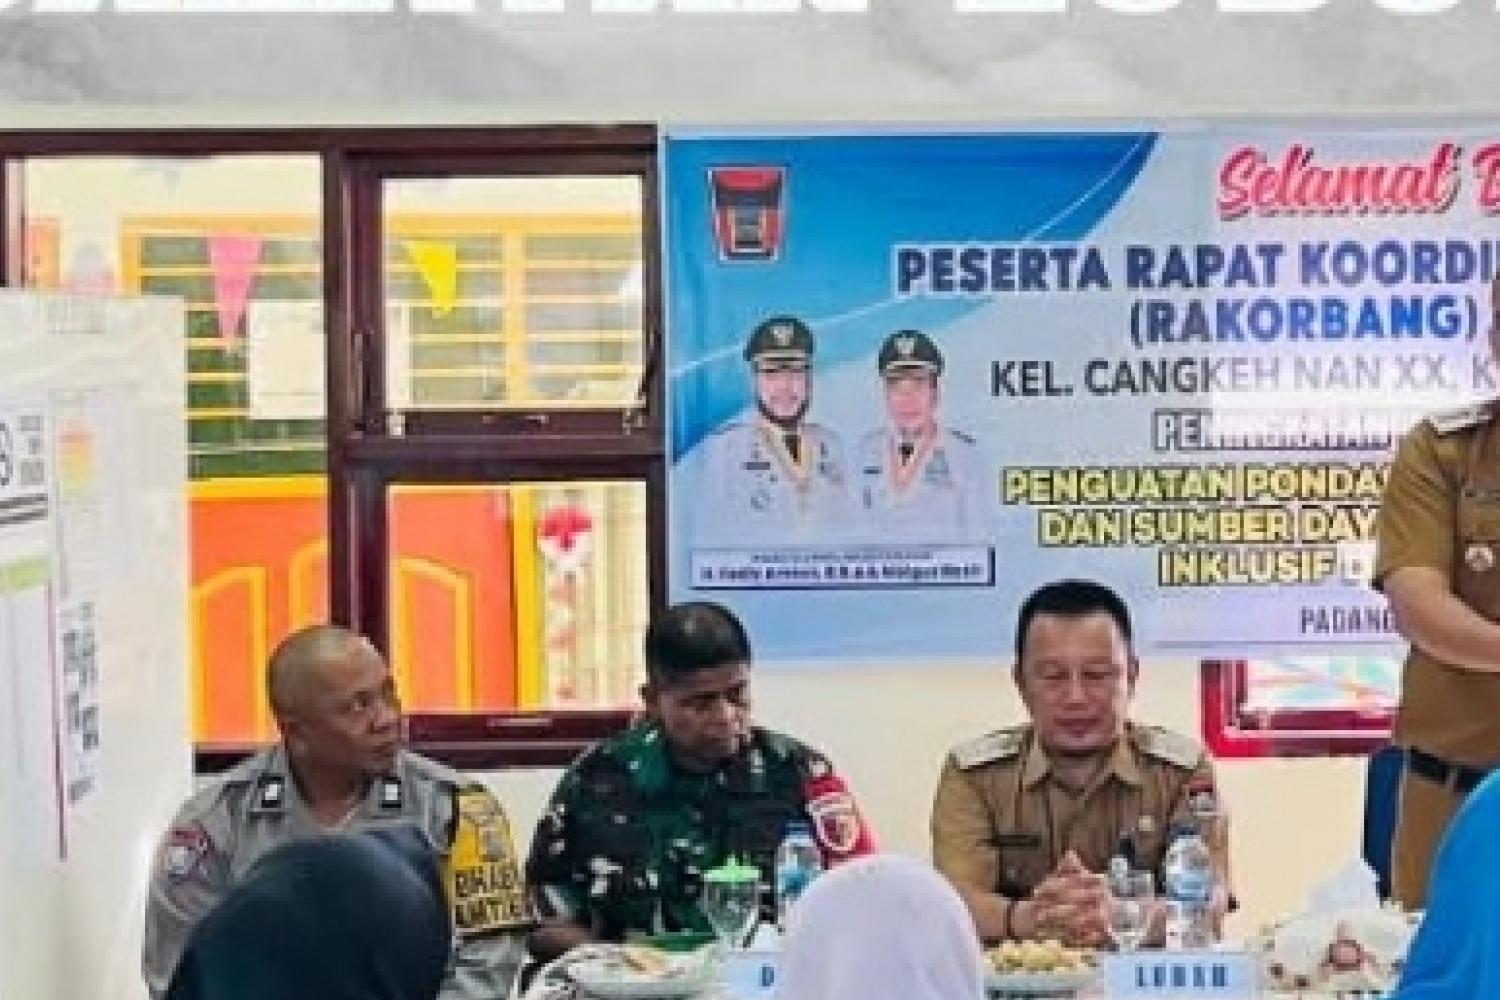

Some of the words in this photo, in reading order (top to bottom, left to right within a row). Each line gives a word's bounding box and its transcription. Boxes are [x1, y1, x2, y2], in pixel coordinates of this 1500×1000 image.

[1220, 143, 1461, 220] Selamat
[897, 246, 1112, 292] PESERTA
[1125, 243, 1284, 289] RAPAT
[1131, 295, 1478, 349] (RAKORBANG)
[991, 360, 1074, 397] KEL.
[1084, 357, 1280, 394] CANGKEH
[1294, 356, 1381, 390] NAN
[1002, 465, 1235, 504] PENGUATAN
[1243, 463, 1388, 503] PONDA
[1038, 508, 1126, 547] DAN
[1130, 505, 1297, 546] SUMBER
[1300, 504, 1381, 544] DAY
[1157, 546, 1339, 588] INKLUSIF
